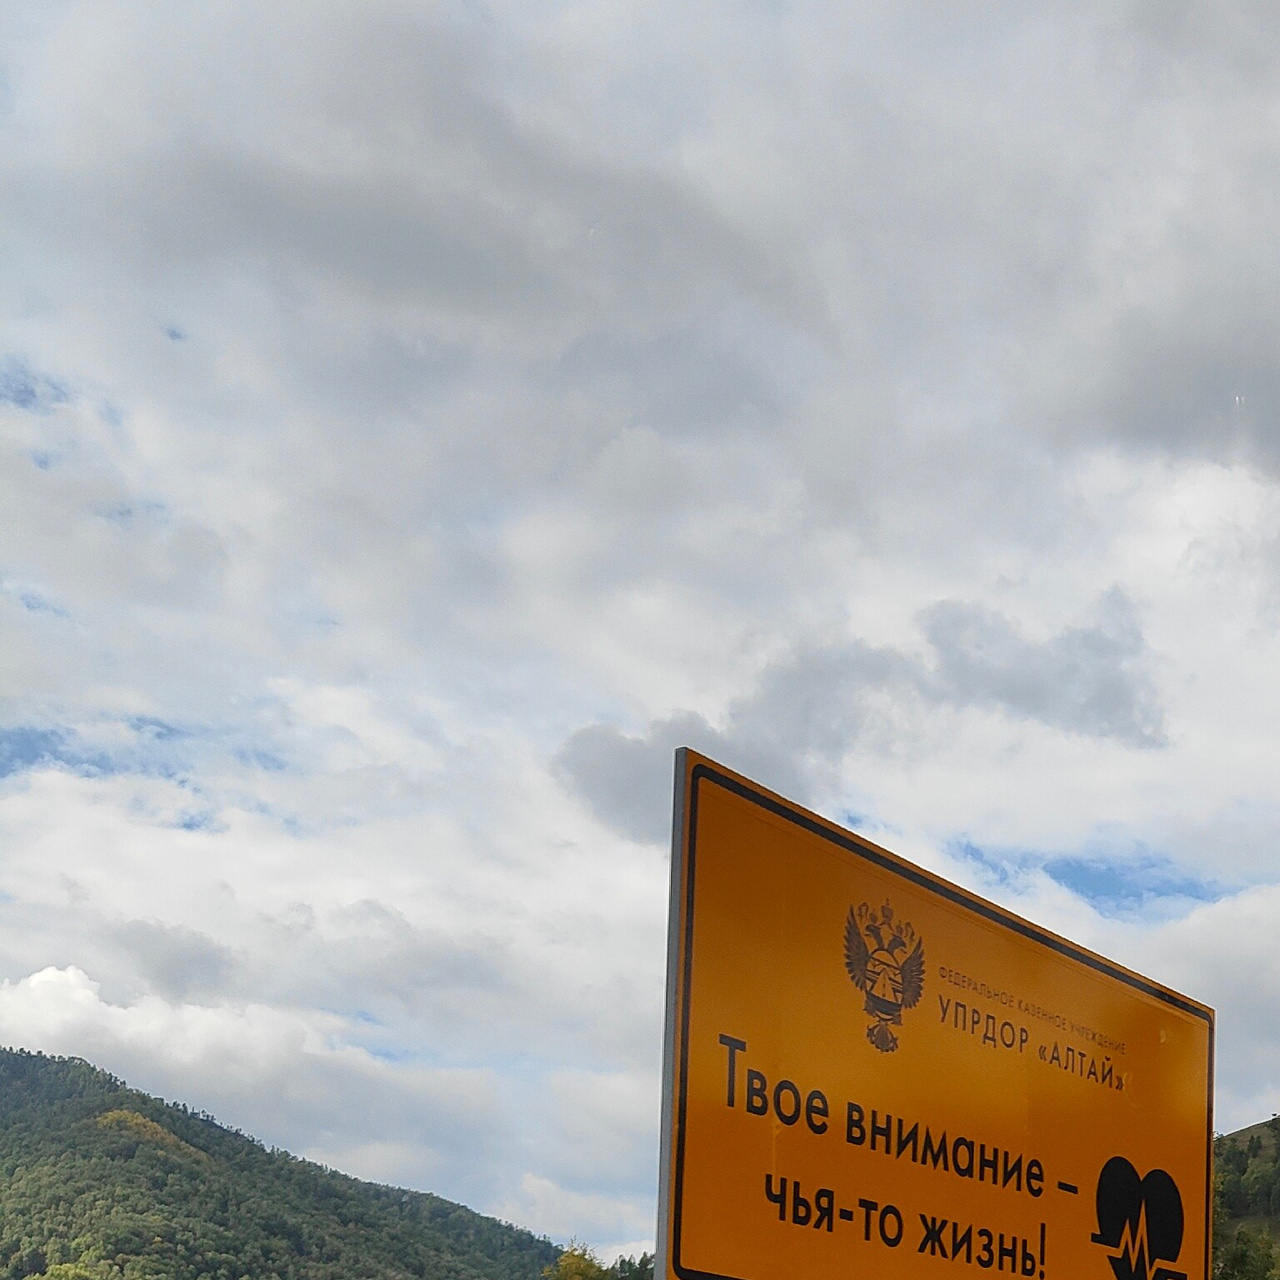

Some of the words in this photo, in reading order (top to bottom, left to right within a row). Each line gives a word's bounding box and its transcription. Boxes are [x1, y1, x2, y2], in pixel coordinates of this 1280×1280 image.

[938, 966, 1014, 1009] ФЕДЕРАЛЬНОЕ
[938, 995, 1029, 1053] УПРДОР
[1038, 1041, 1125, 1091] «АЛТАЙ»
[718, 1033, 830, 1136] Твое
[846, 1102, 1045, 1198] внимание
[764, 1173, 904, 1248] чья-то
[918, 1212, 1047, 1280] жизнь!
